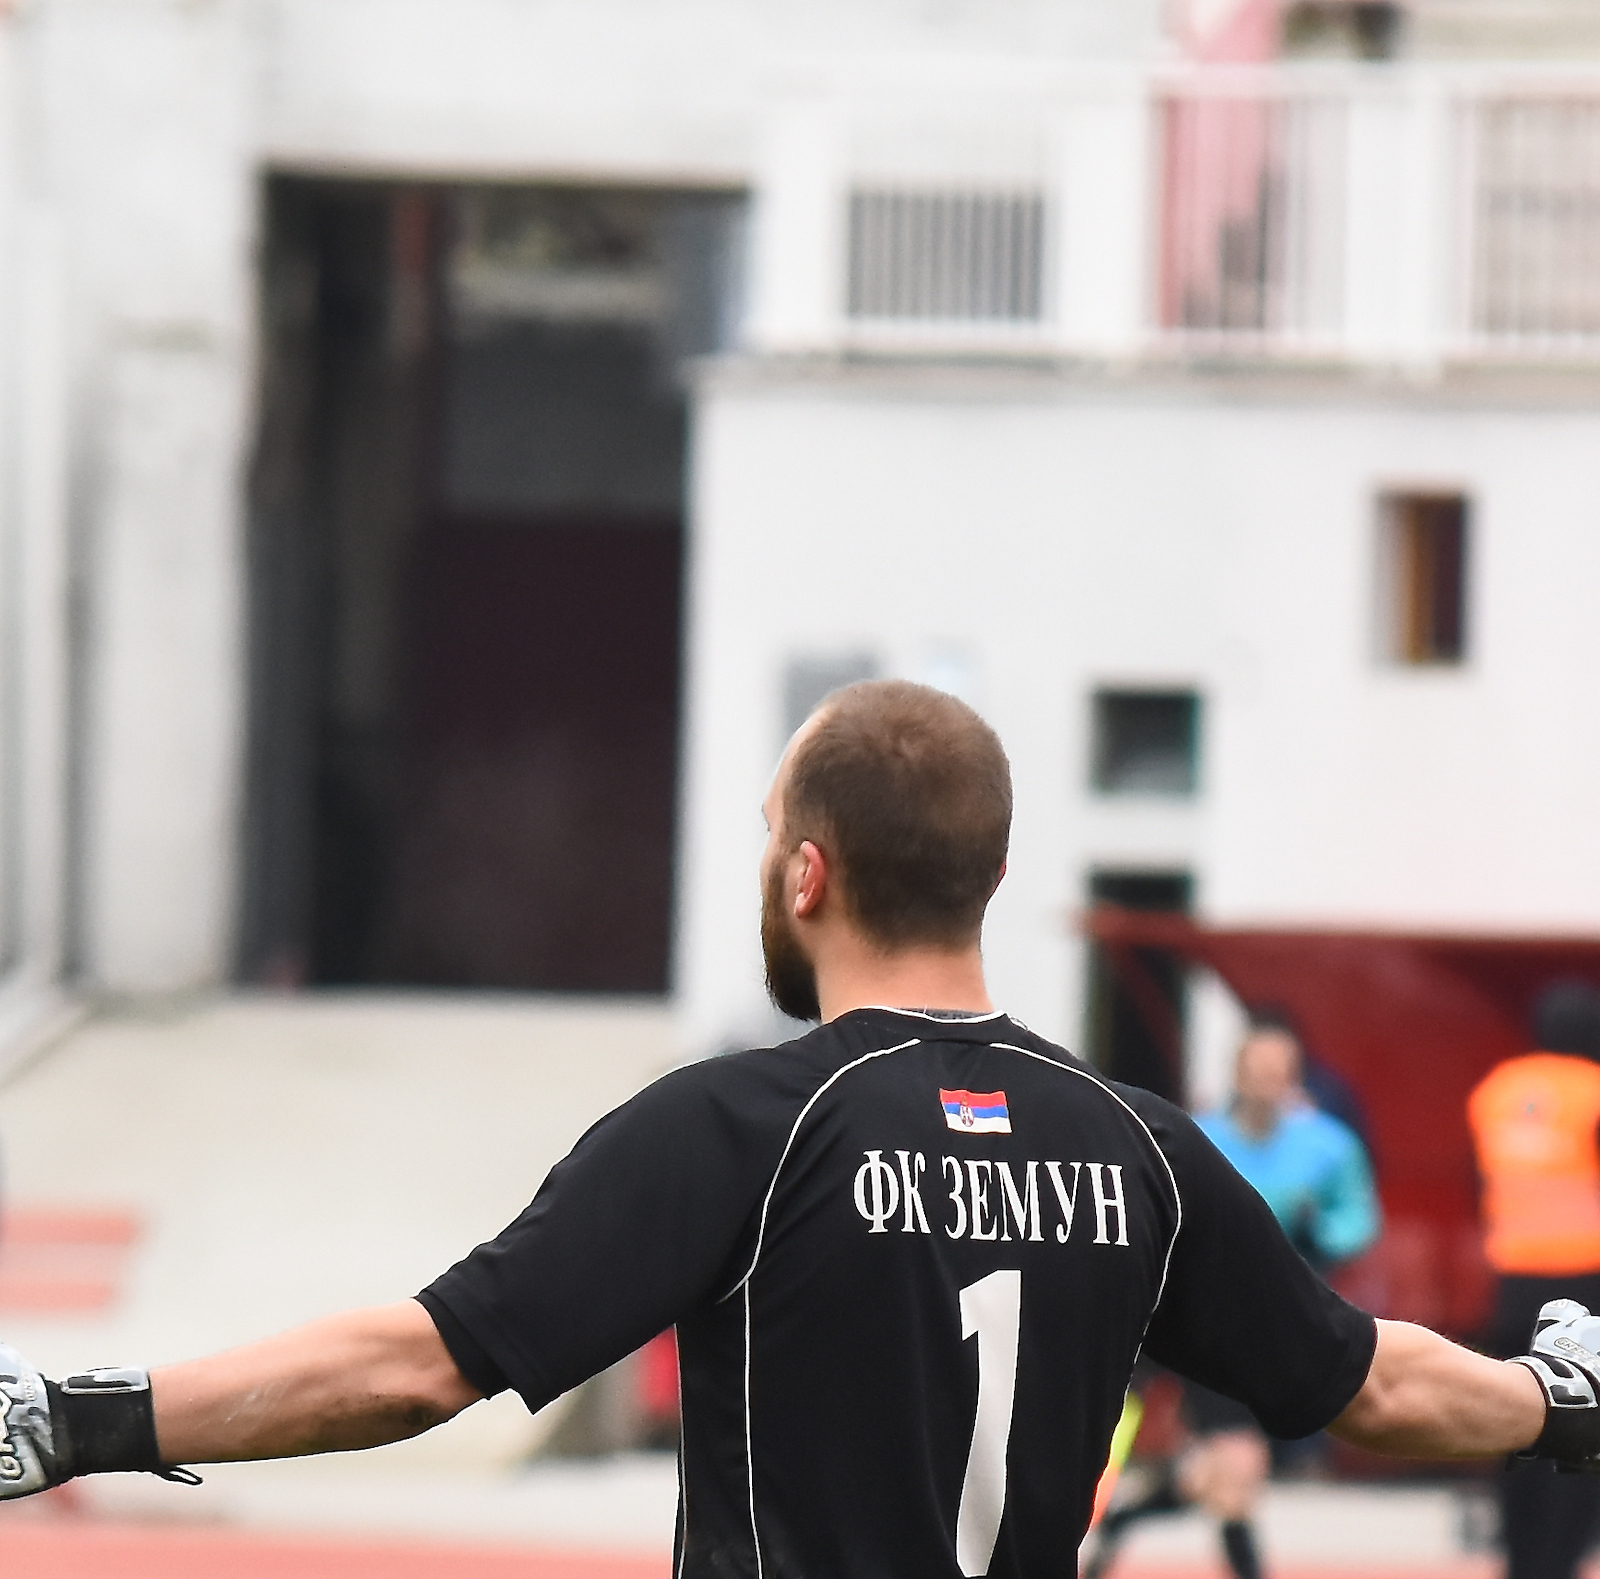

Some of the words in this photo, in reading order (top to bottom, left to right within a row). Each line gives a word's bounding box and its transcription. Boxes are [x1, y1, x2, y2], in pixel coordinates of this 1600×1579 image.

[853, 1149, 932, 1234] ФК
[941, 1154, 1130, 1247] ЗЕМУН
[956, 1269, 1022, 1578] 1
